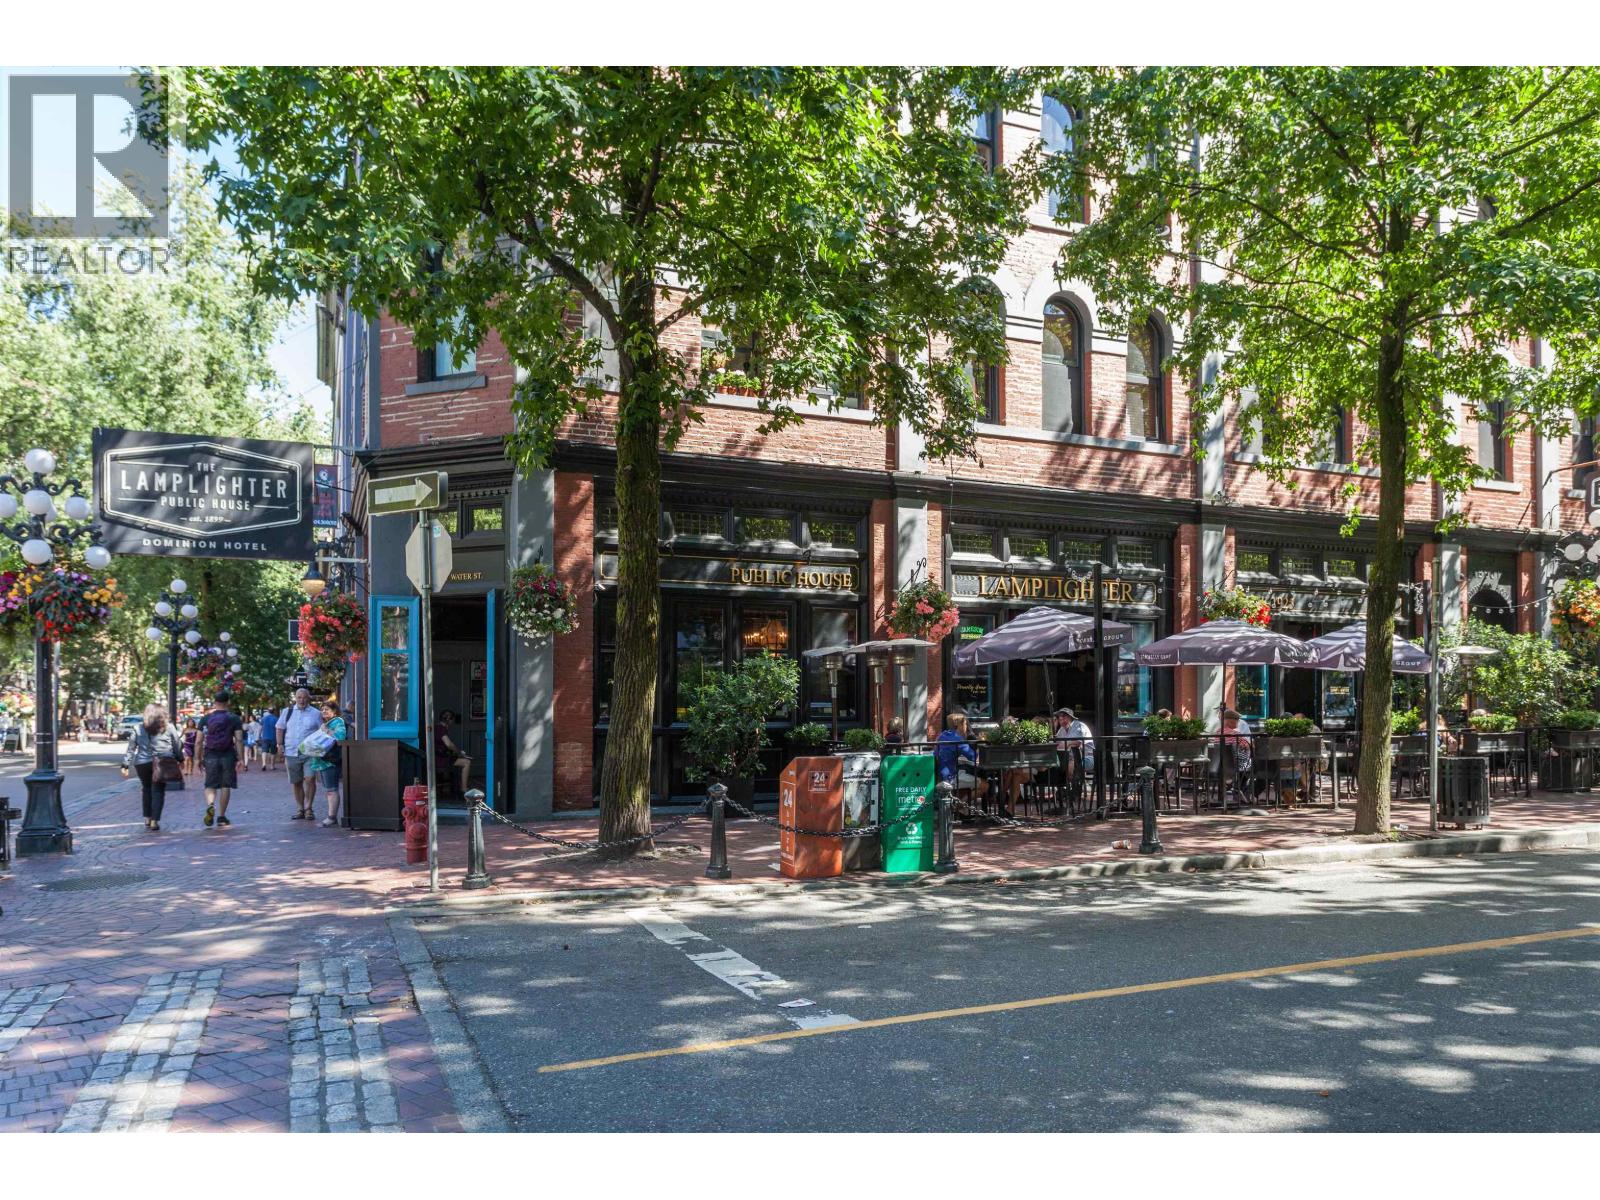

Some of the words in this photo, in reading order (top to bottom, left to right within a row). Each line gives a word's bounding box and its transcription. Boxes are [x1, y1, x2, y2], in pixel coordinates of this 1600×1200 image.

[196, 462, 216, 472] THE
[120, 470, 288, 499] LAMPLIGHTER
[160, 496, 205, 509] PUBLIC
[212, 498, 251, 511] HOUSE
[142, 538, 217, 549] DOMINION
[223, 541, 268, 551] HOTEL
[450, 572, 472, 580] WATER
[473, 571, 482, 580] ST
[731, 567, 793, 586] PUBLIC
[795, 571, 853, 588] HOUSE
[978, 574, 1135, 602] LAMPLIGHTER
[814, 772, 826, 784] 24
[895, 786, 909, 794] FREE
[783, 788, 793, 808] 24
